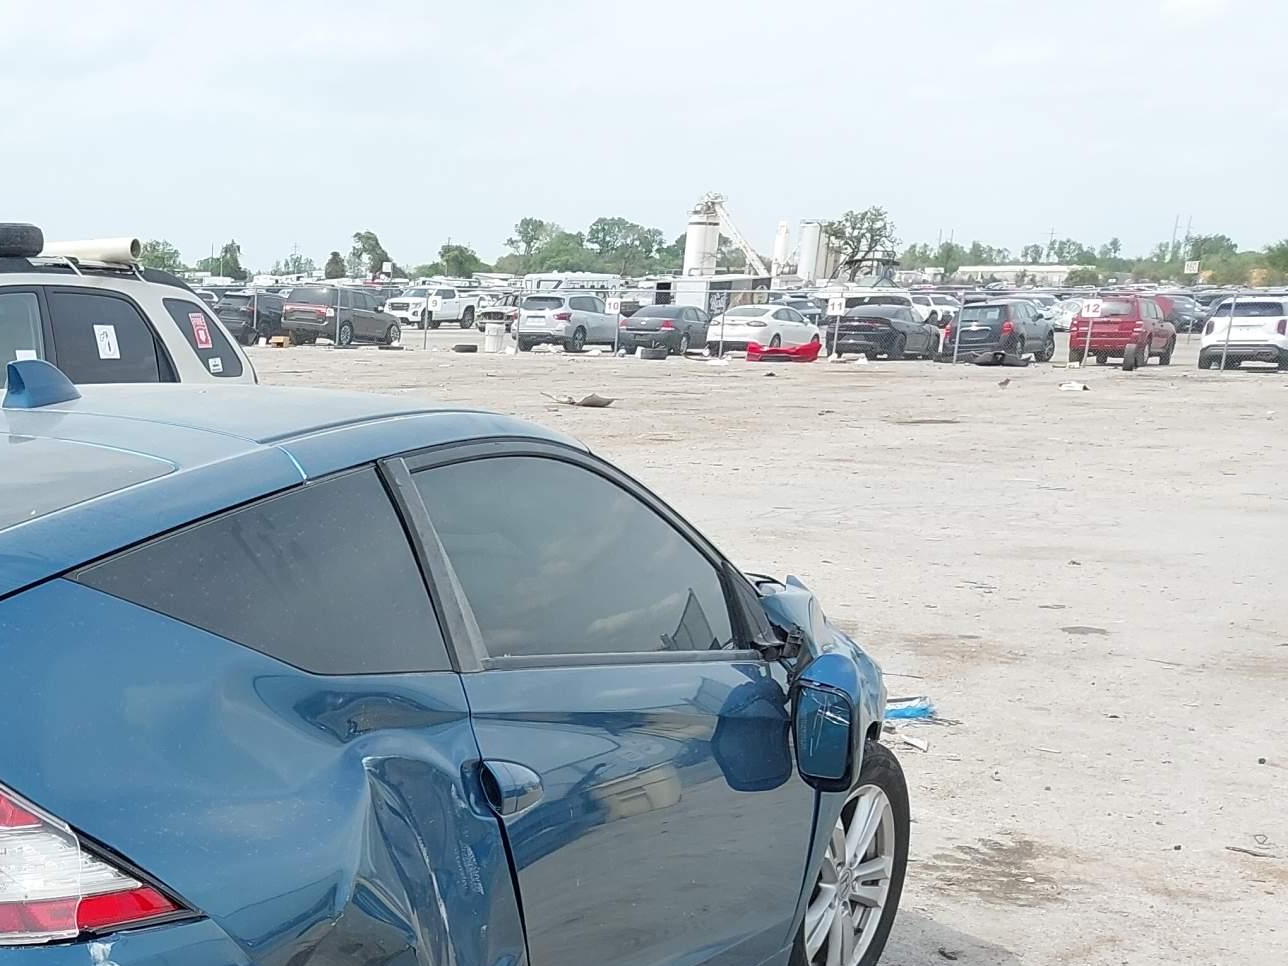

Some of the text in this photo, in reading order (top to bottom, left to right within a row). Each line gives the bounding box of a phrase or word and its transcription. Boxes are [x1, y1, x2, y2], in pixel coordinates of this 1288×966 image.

[431, 299, 438, 308] 9
[607, 302, 619, 310] 10
[830, 302, 843, 311] 11
[1084, 303, 1100, 313] 12
